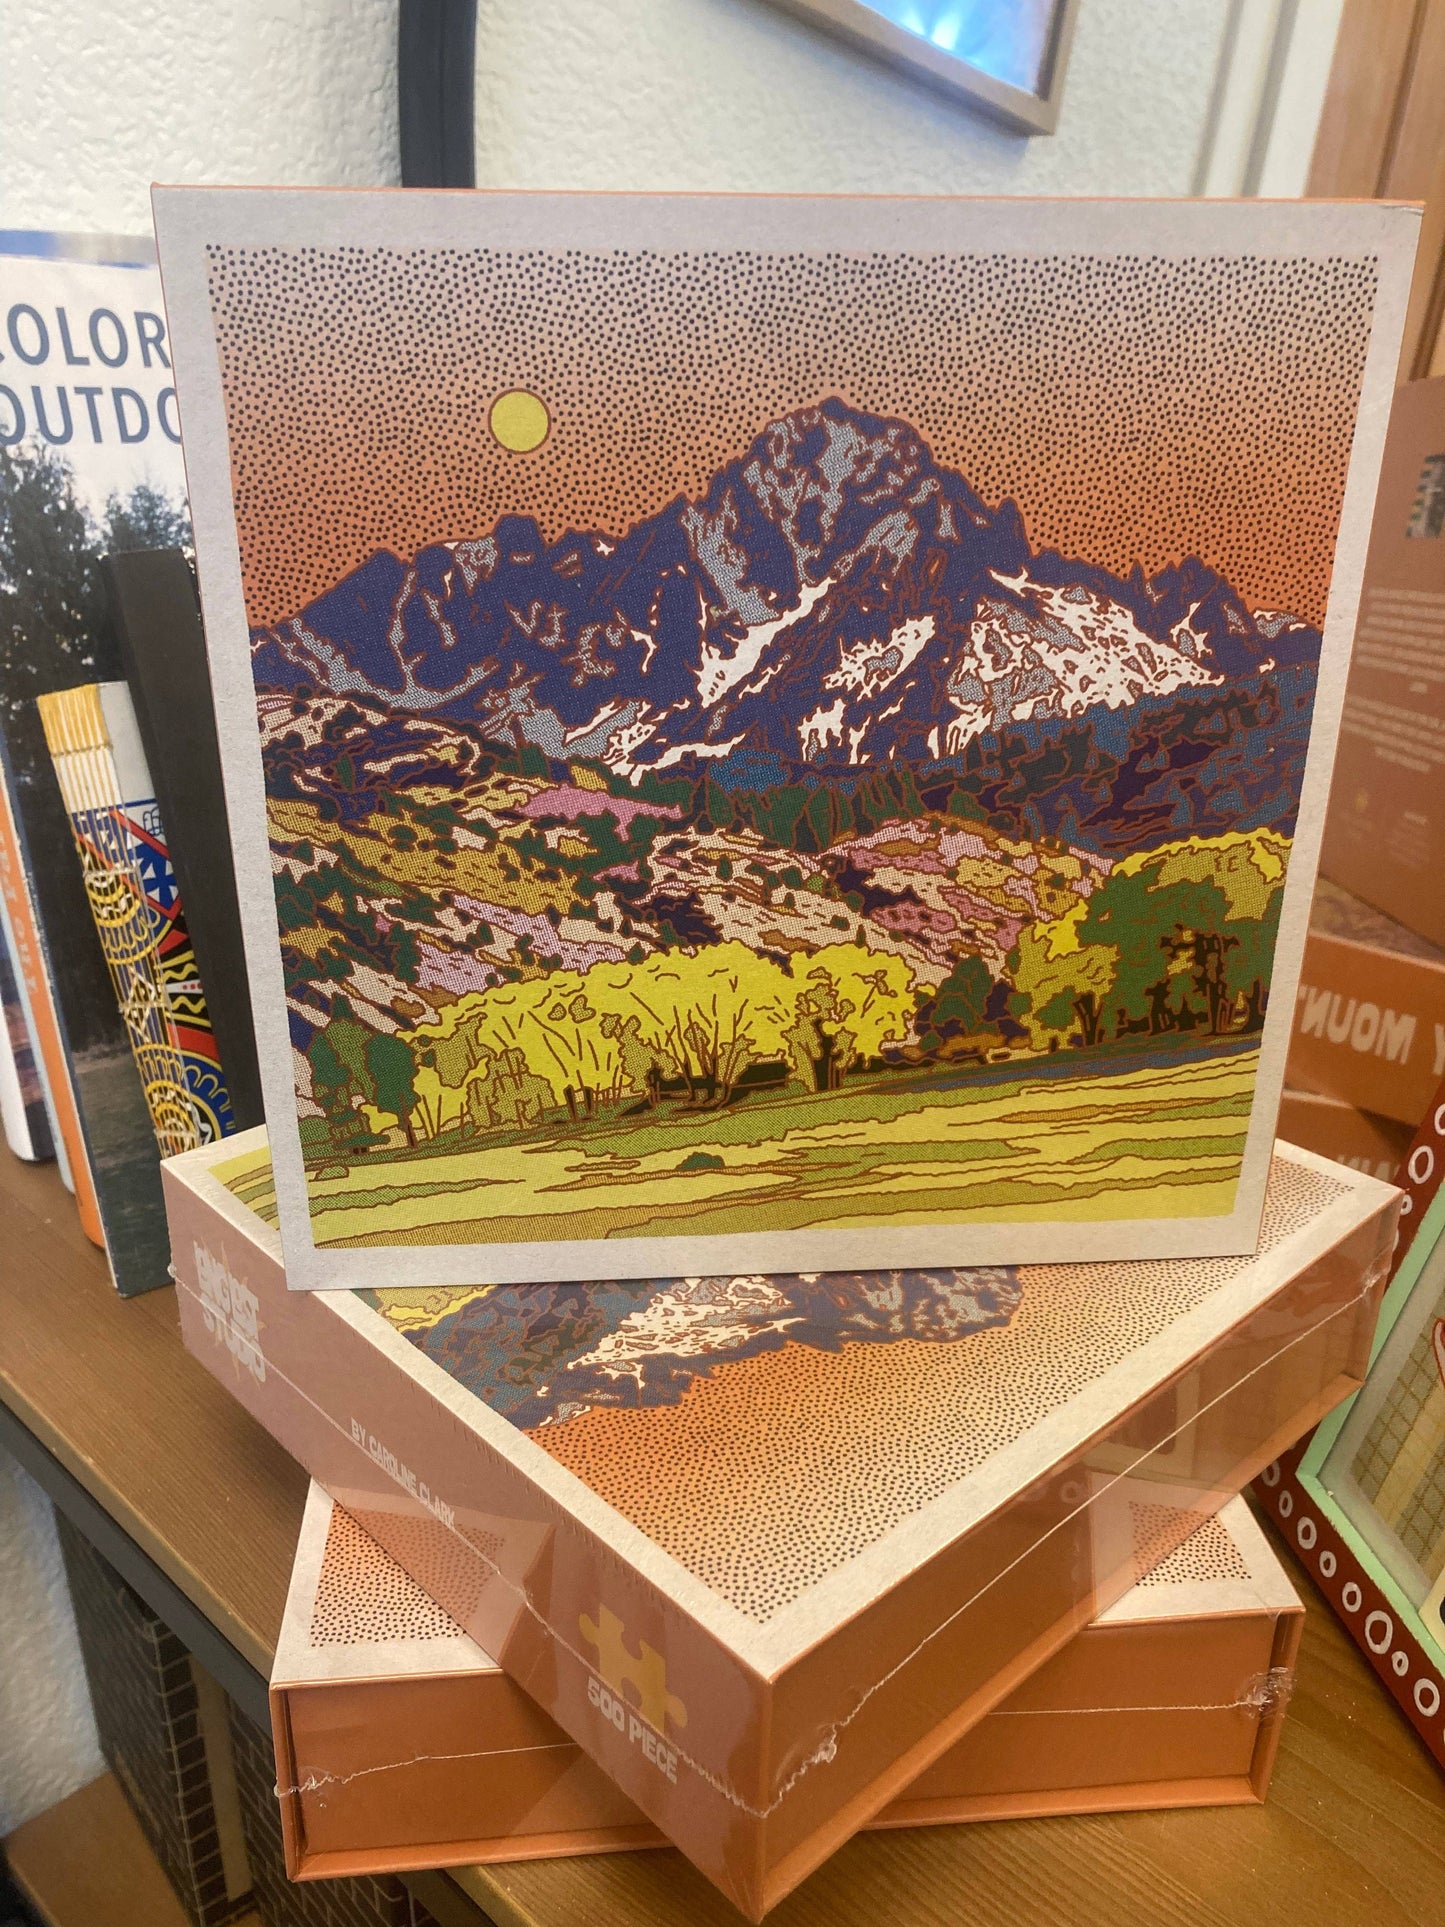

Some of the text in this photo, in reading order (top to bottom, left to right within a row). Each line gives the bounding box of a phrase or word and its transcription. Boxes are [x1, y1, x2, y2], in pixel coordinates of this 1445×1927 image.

[0, 303, 172, 368] OLOR
[351, 1416, 455, 1533] BY CAROLINE CLARK
[587, 1675, 678, 1785] 500 PIECE
